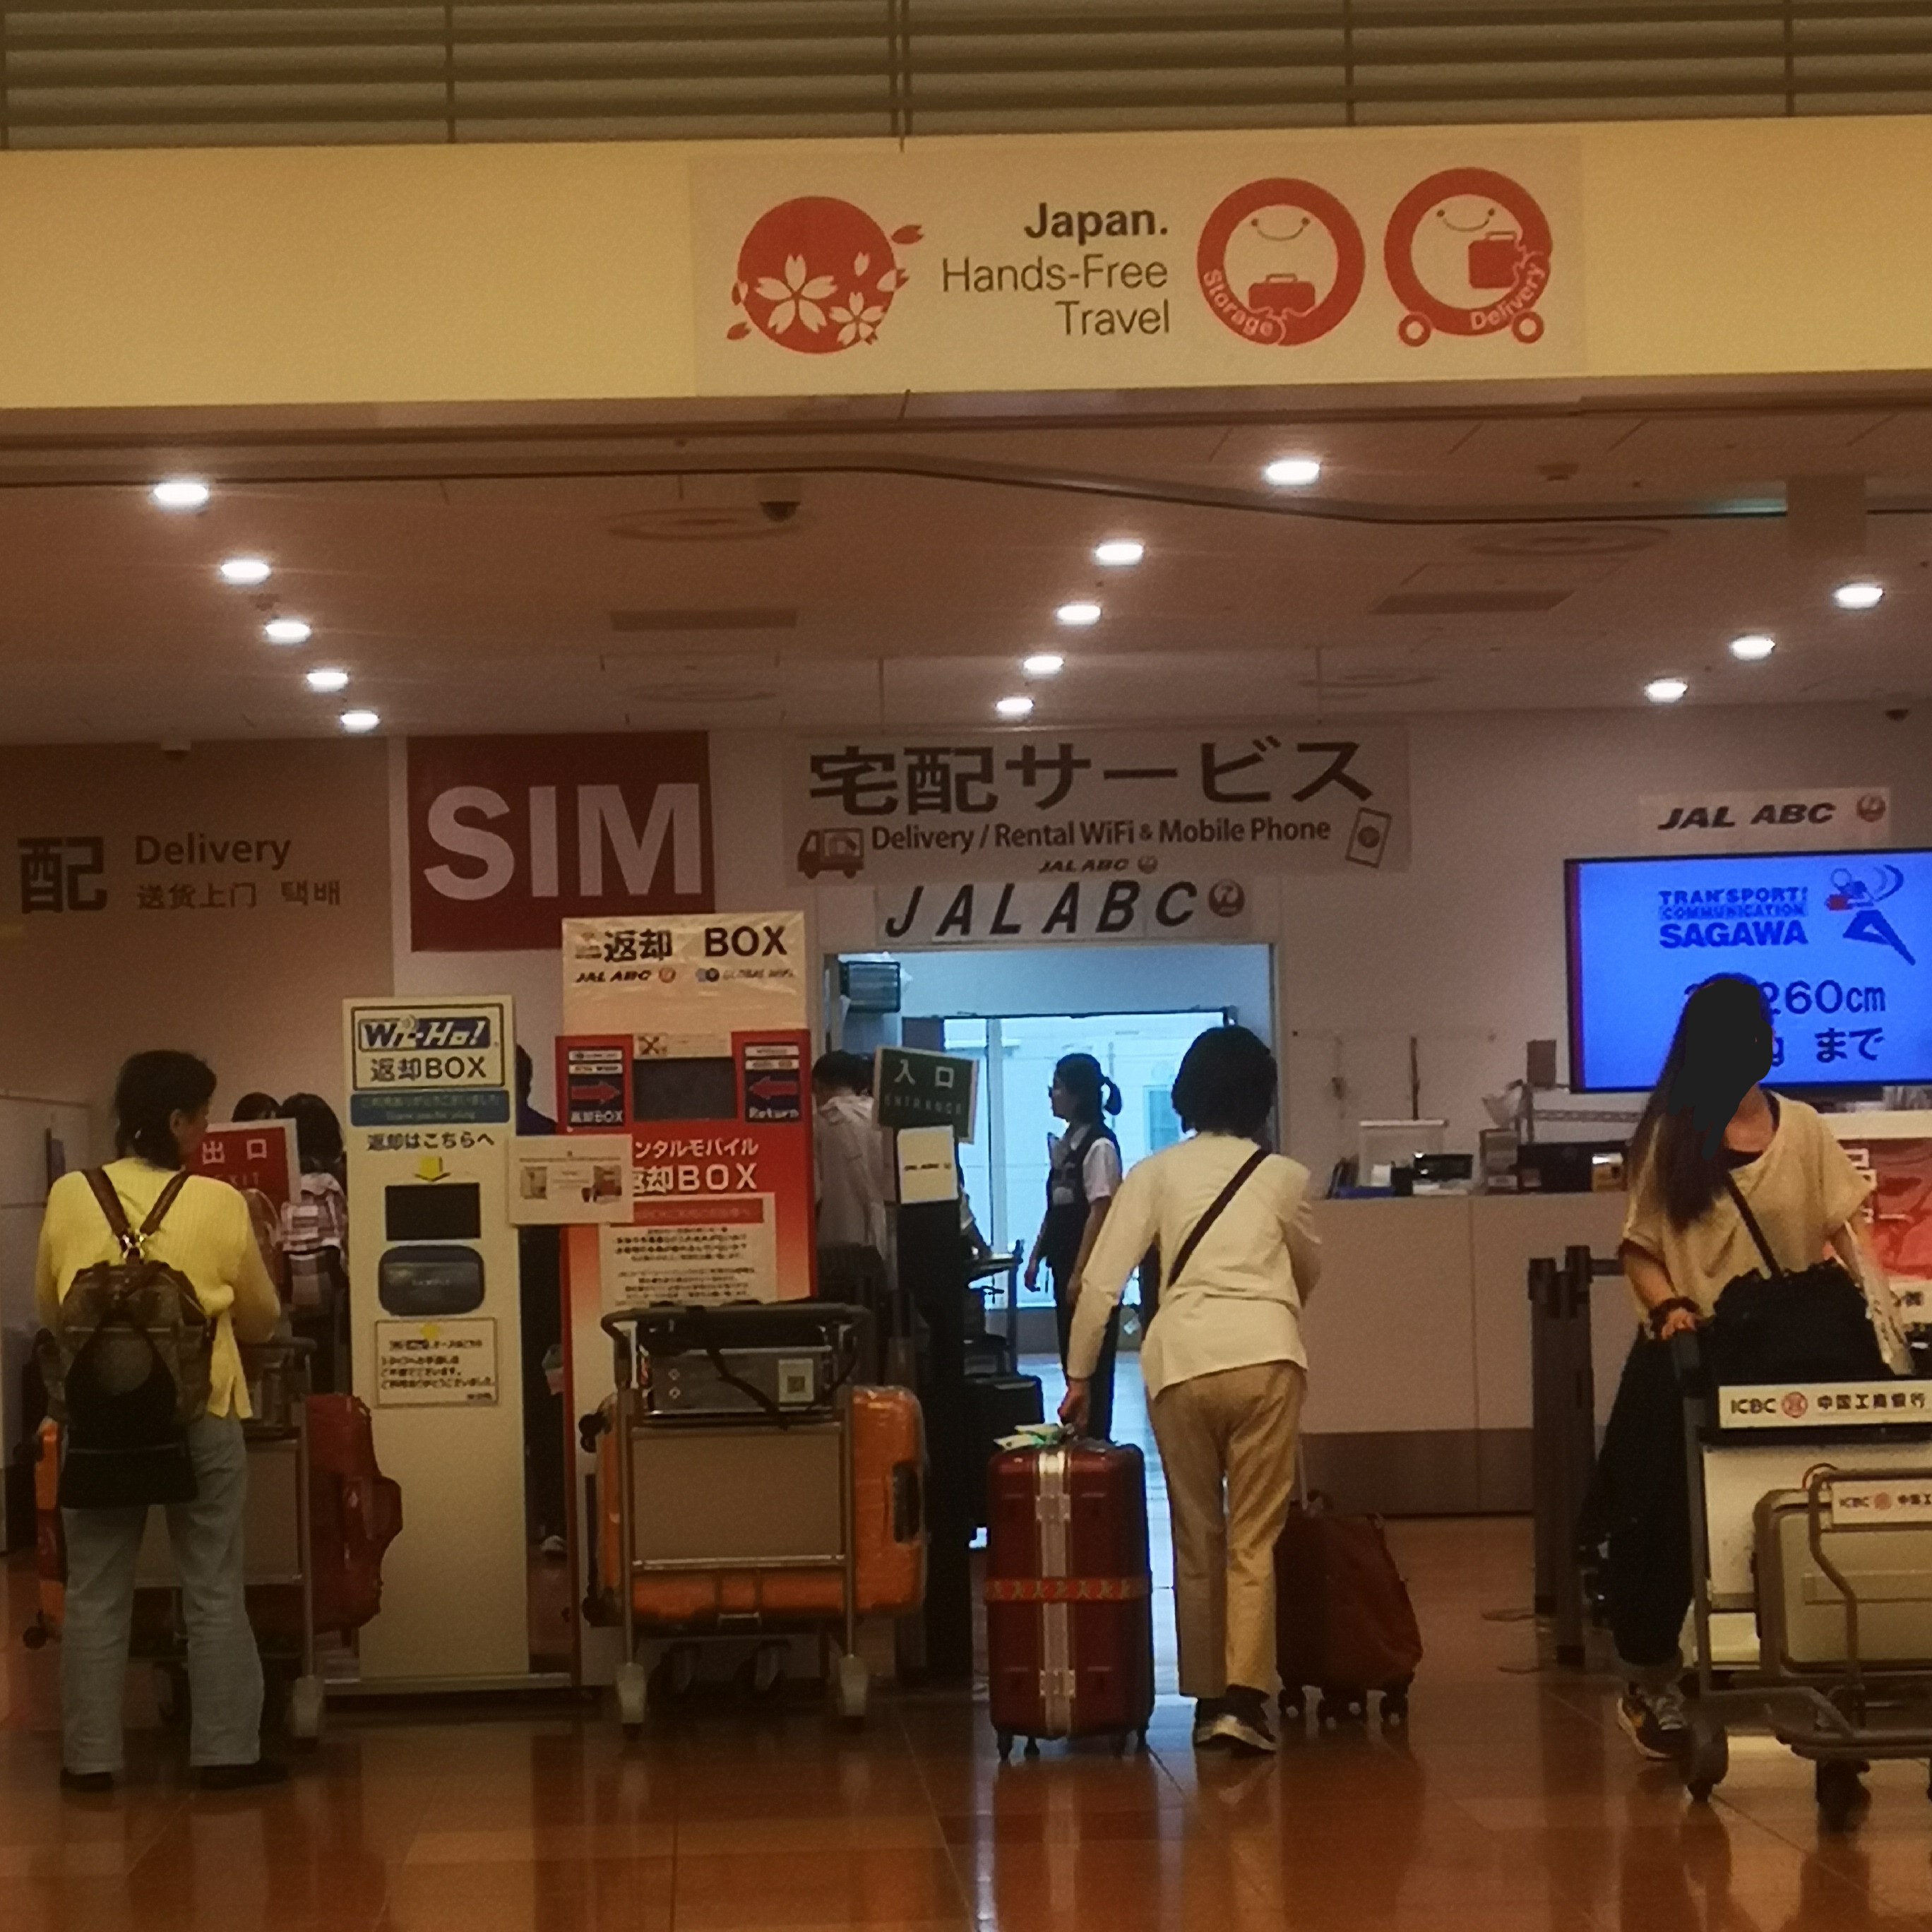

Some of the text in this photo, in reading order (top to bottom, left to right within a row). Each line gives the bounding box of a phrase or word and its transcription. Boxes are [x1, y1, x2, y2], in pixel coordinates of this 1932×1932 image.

[1024, 202, 1168, 246] Japan.
[942, 253, 1168, 292] Hands-Free
[1203, 268, 1274, 338] Storage
[1469, 263, 1546, 330] Delivery
[1054, 298, 1170, 336] Travel
[809, 734, 1373, 816] 宅配サービス
[1657, 802, 1836, 830] JAL ABC
[134, 832, 292, 871] Delivery
[424, 782, 703, 901] SIM
[871, 823, 974, 855] Delivery
[994, 819, 1075, 847] Rental
[1079, 819, 1135, 845] WiFi
[1138, 823, 1154, 842] &
[1158, 818, 1246, 844] Mobile
[1251, 816, 1331, 842] Phone
[17, 836, 108, 914] 配
[1038, 857, 1129, 874] JAL ABC
[136, 881, 257, 910] 送货上门
[884, 879, 1198, 938] JAL ABC
[705, 925, 788, 957] BOX
[1659, 919, 1809, 949] SAGAWA
[1814, 1027, 1885, 1063] まで
[371, 1056, 487, 1083] 返却BOX
[894, 1059, 955, 1088] 入口
[202, 1138, 268, 1165] 出口
